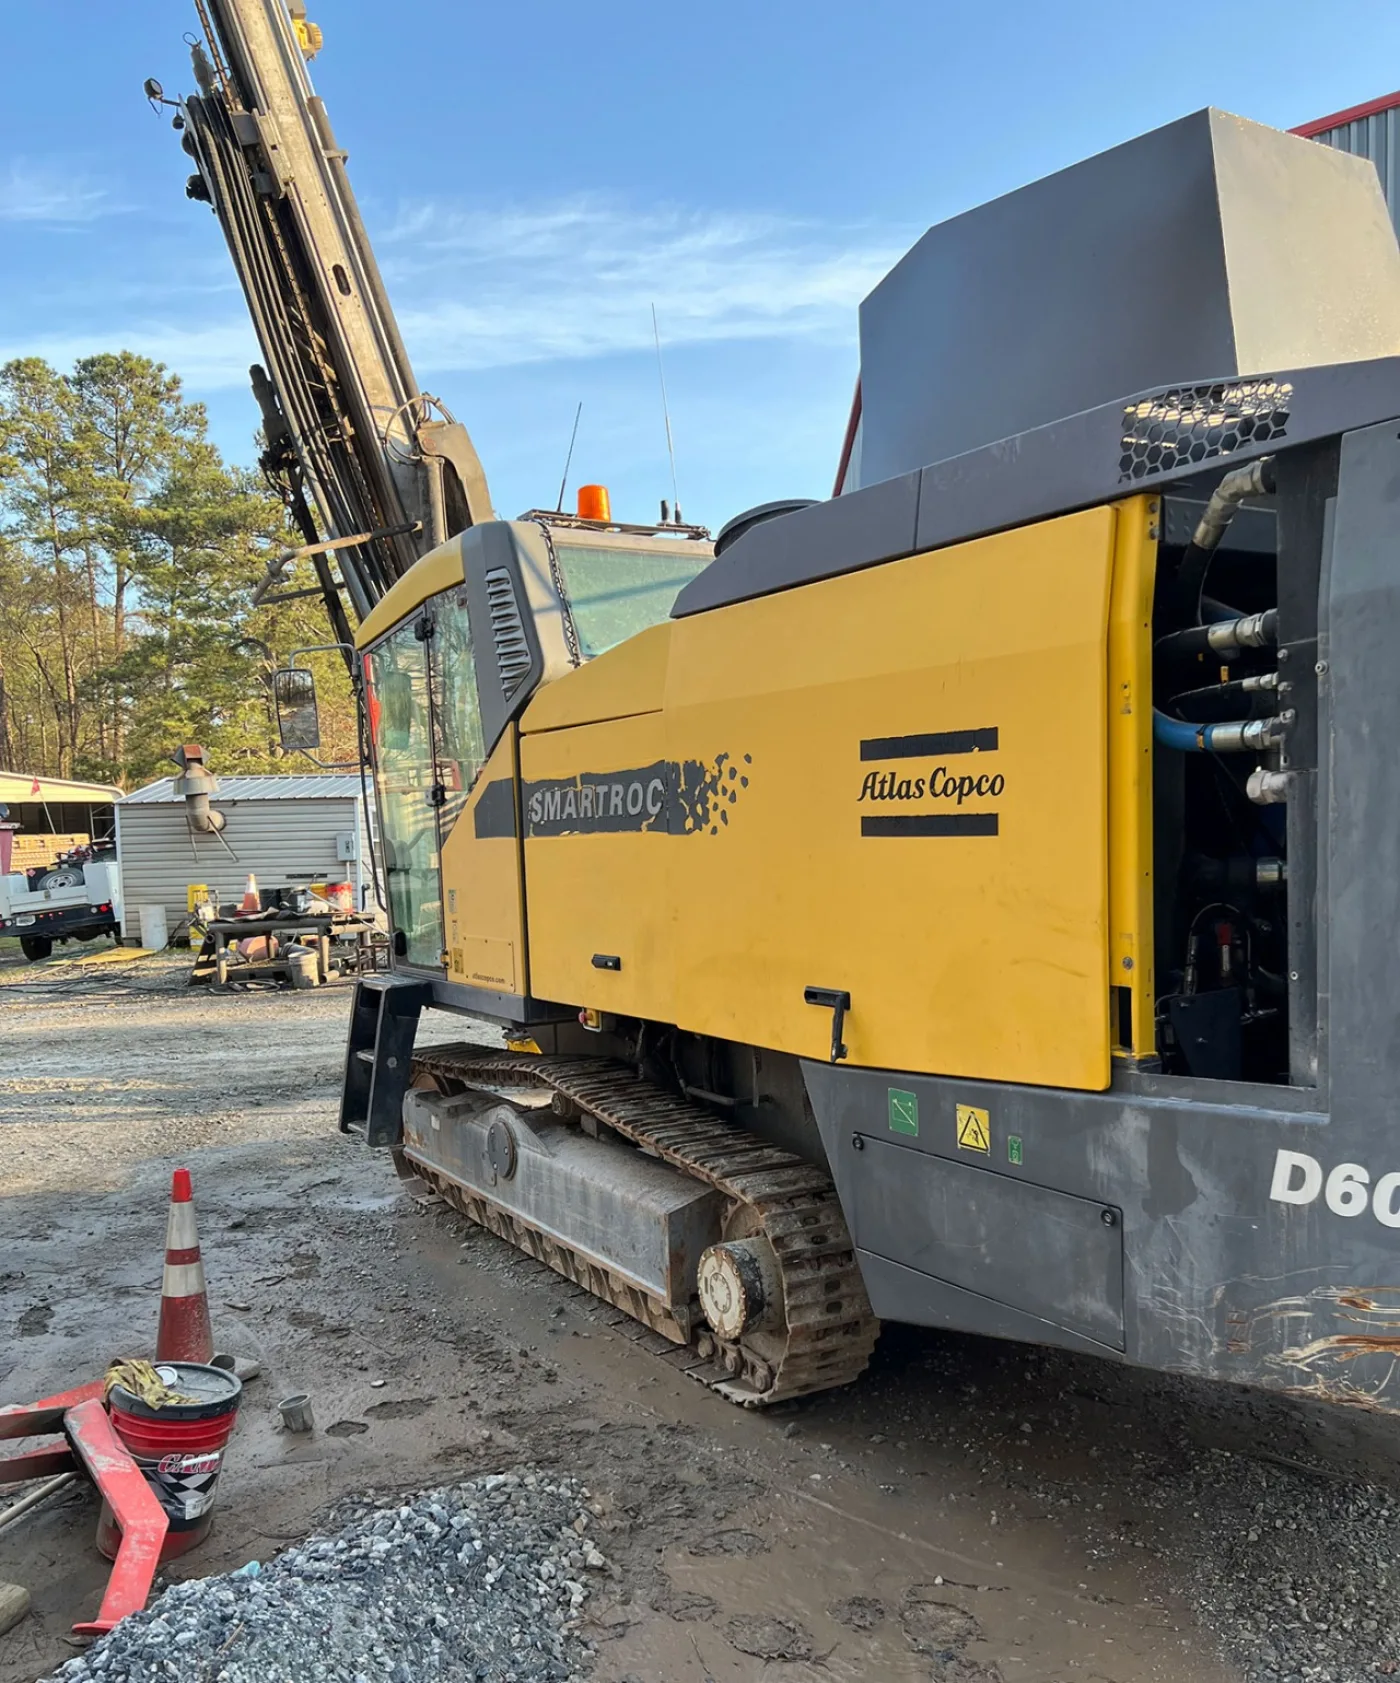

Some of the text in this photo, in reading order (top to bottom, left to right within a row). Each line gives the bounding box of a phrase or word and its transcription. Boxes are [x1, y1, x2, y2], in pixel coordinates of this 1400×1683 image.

[531, 778, 665, 823] SMARTROC
[857, 766, 1005, 805] Atlas Copco
